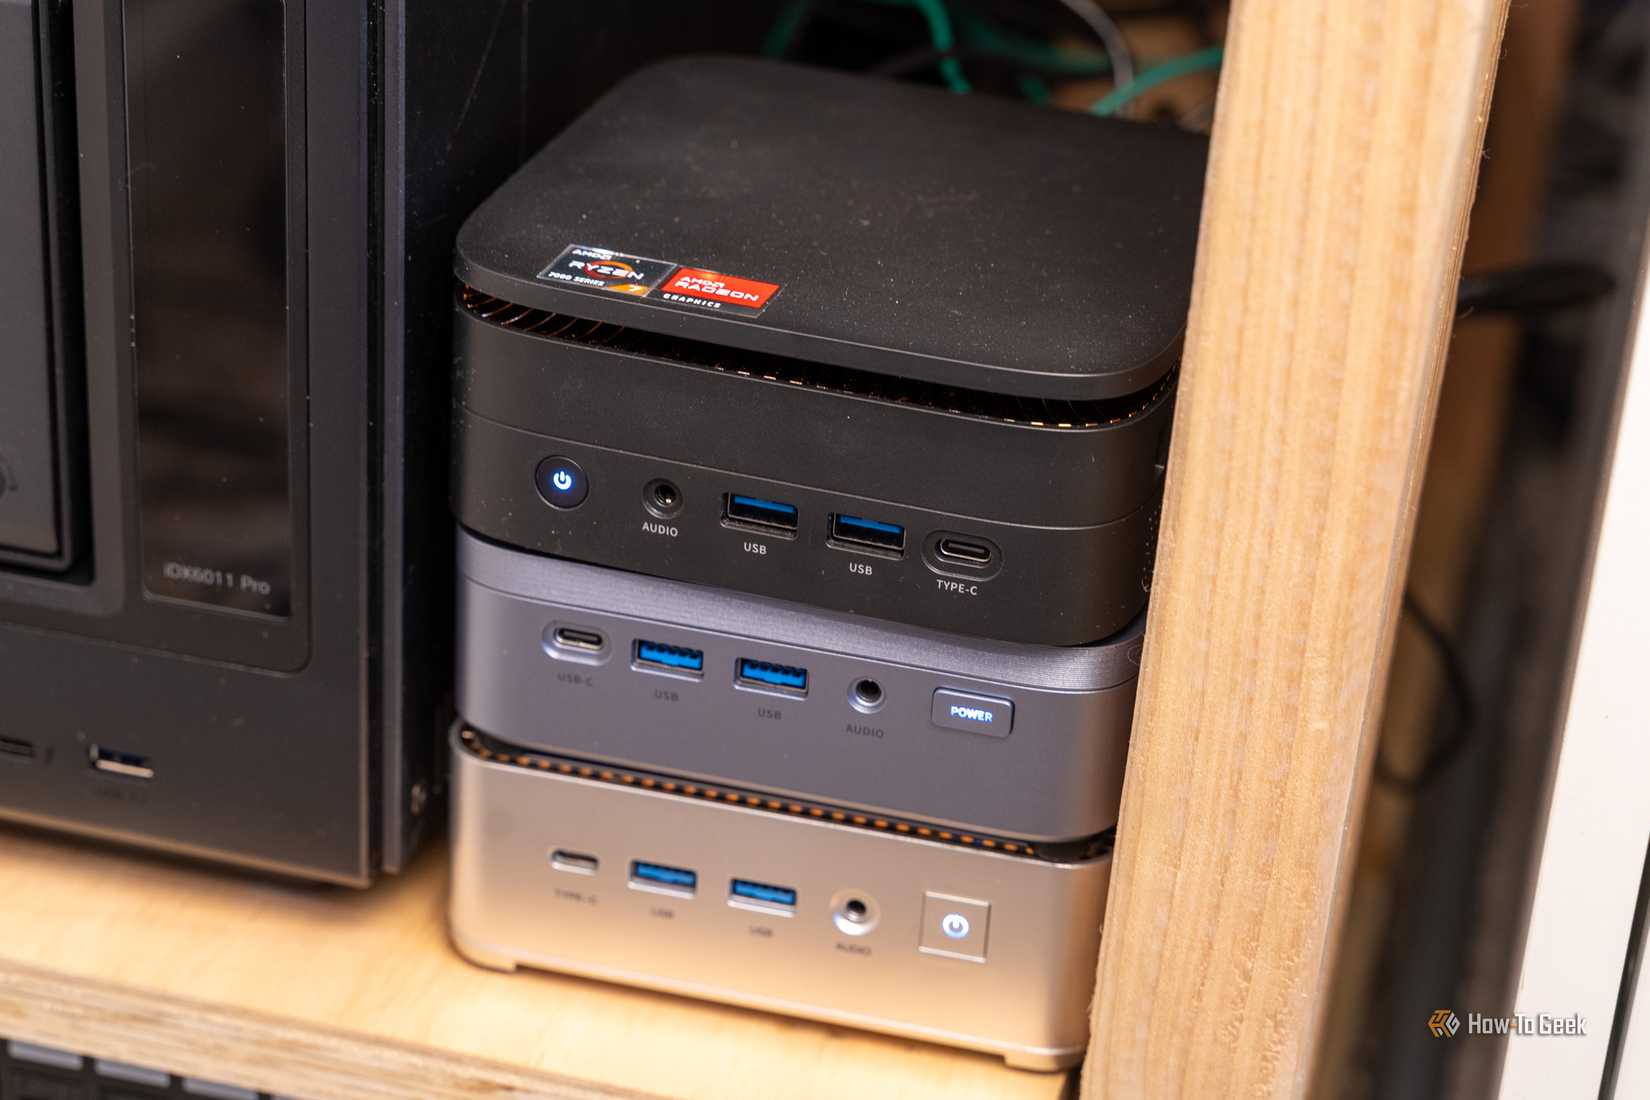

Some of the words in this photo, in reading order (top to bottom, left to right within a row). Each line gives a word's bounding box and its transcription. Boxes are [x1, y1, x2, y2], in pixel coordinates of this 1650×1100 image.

[572, 248, 613, 261] AMD
[568, 260, 644, 279] RYZEN
[573, 275, 606, 287] SERIES
[680, 276, 725, 288] AMD
[675, 281, 759, 302] RADEON
[663, 293, 721, 309] GRAPHICS
[642, 521, 679, 537] AUDIO
[743, 542, 768, 555] USB
[849, 562, 873, 576] USB
[240, 574, 270, 595] Pro
[936, 579, 978, 596] TYPE-C
[654, 688, 680, 702] USB
[757, 708, 782, 721] USB
[950, 705, 993, 723] POWER
[846, 725, 884, 739] AUDIO
